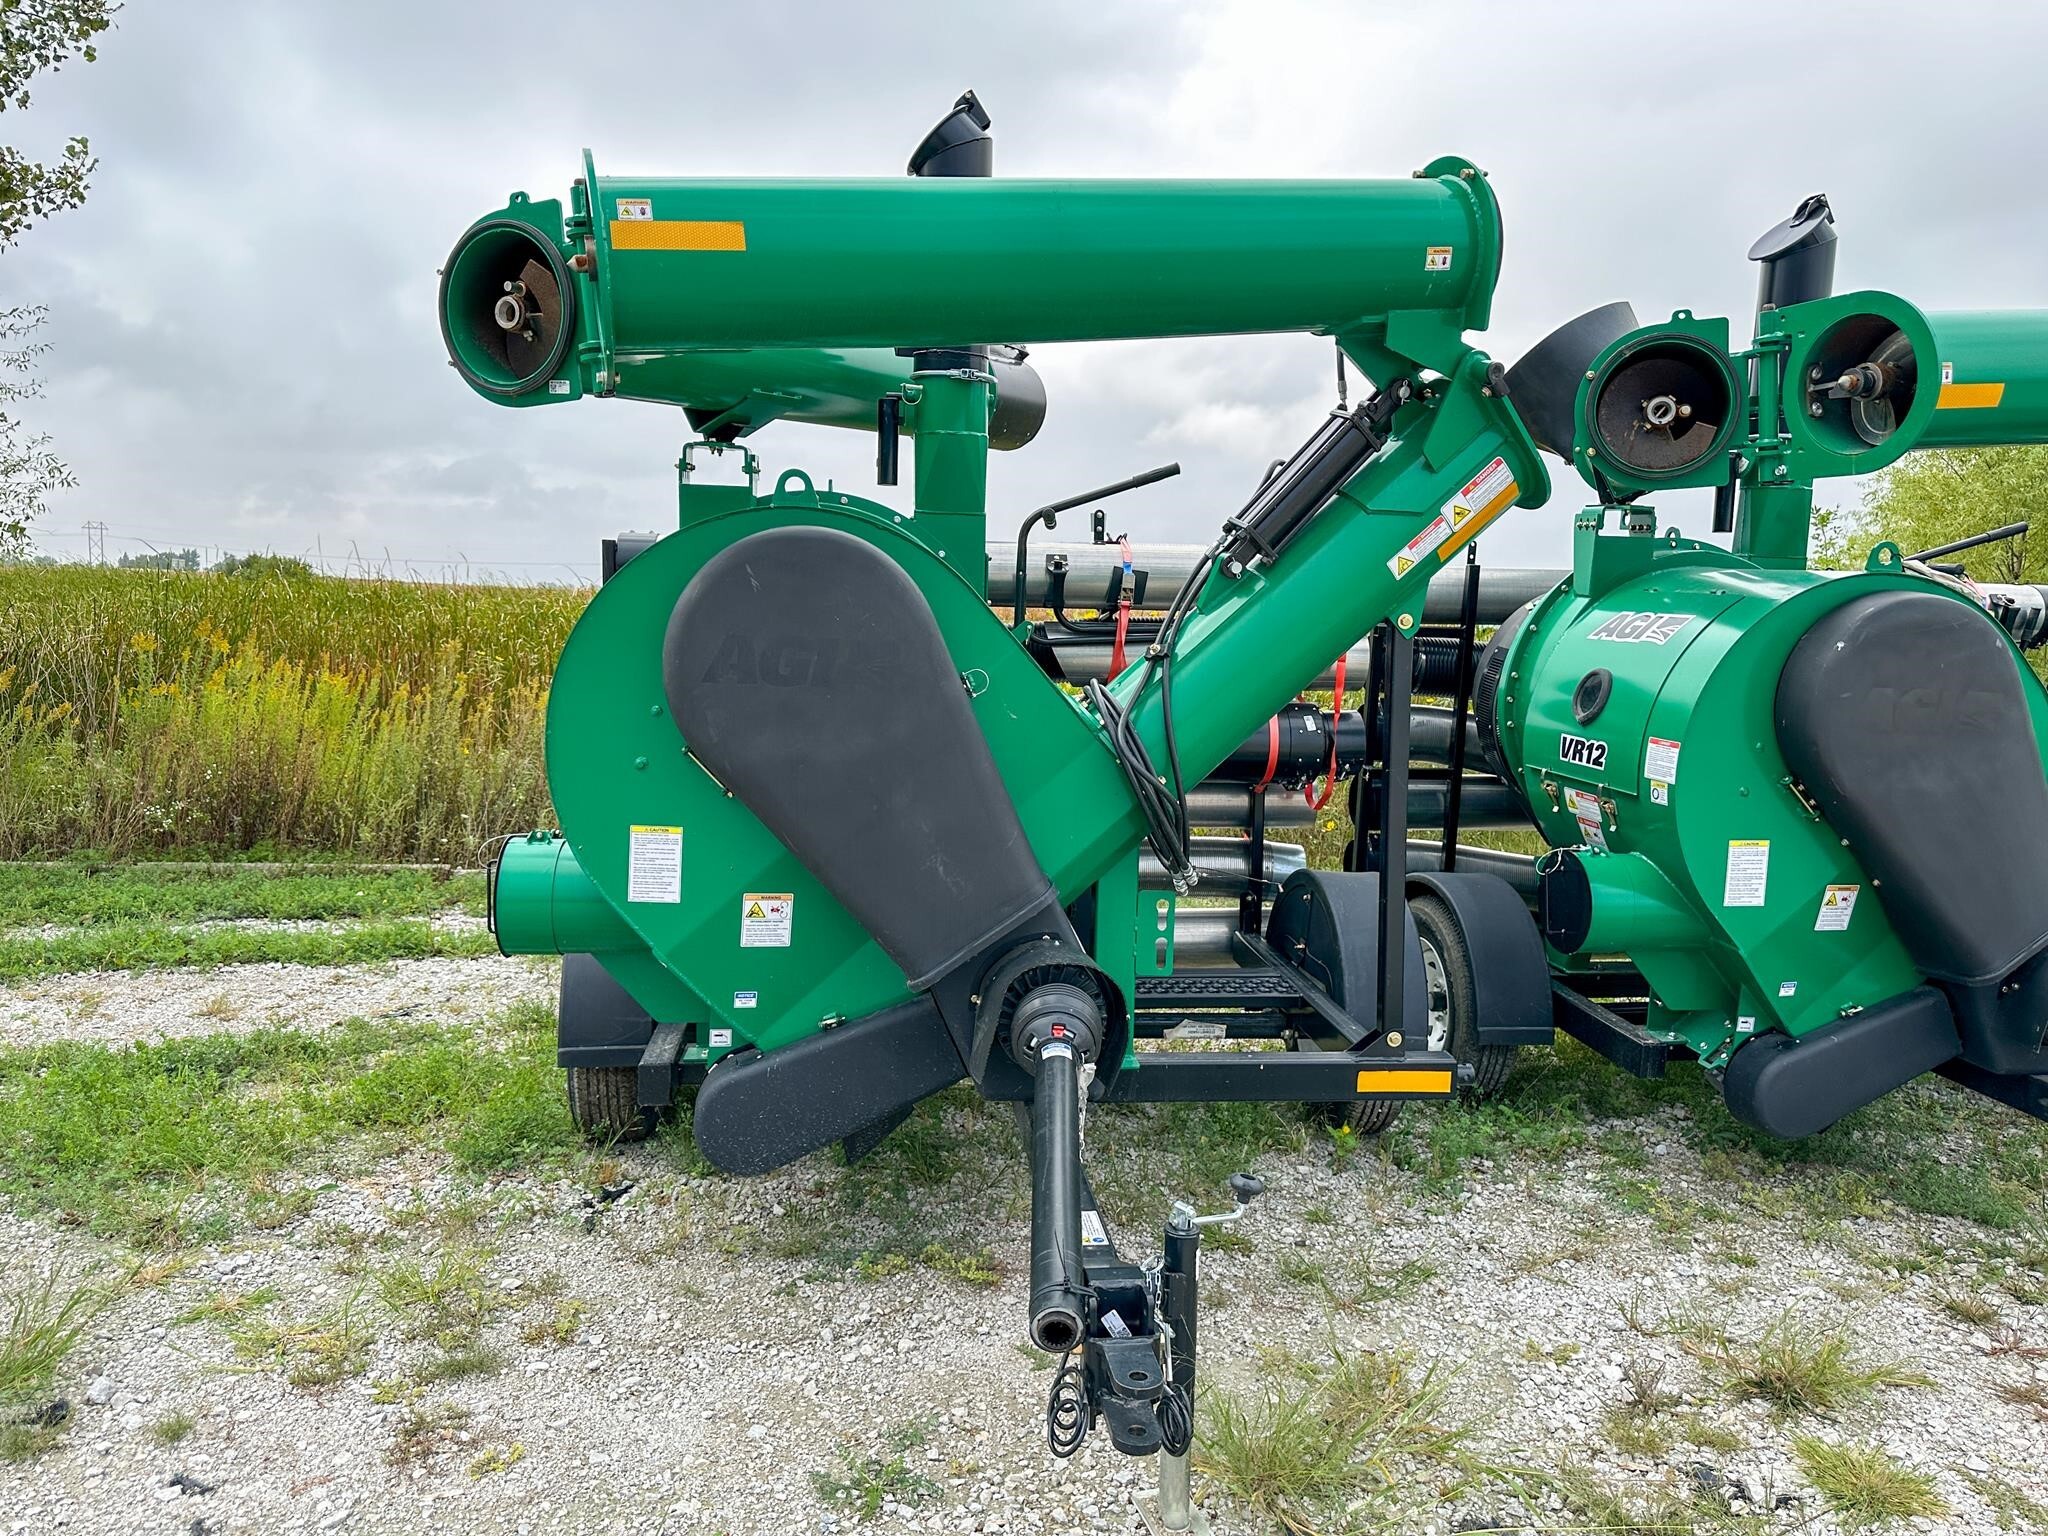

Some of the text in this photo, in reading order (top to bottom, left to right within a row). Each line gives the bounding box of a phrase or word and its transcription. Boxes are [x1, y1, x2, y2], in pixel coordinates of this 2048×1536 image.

[1475, 462, 1498, 484] DANGER
[1588, 611, 1666, 642] AGI
[701, 632, 841, 688] AGI
[1561, 735, 1607, 768] VR12
